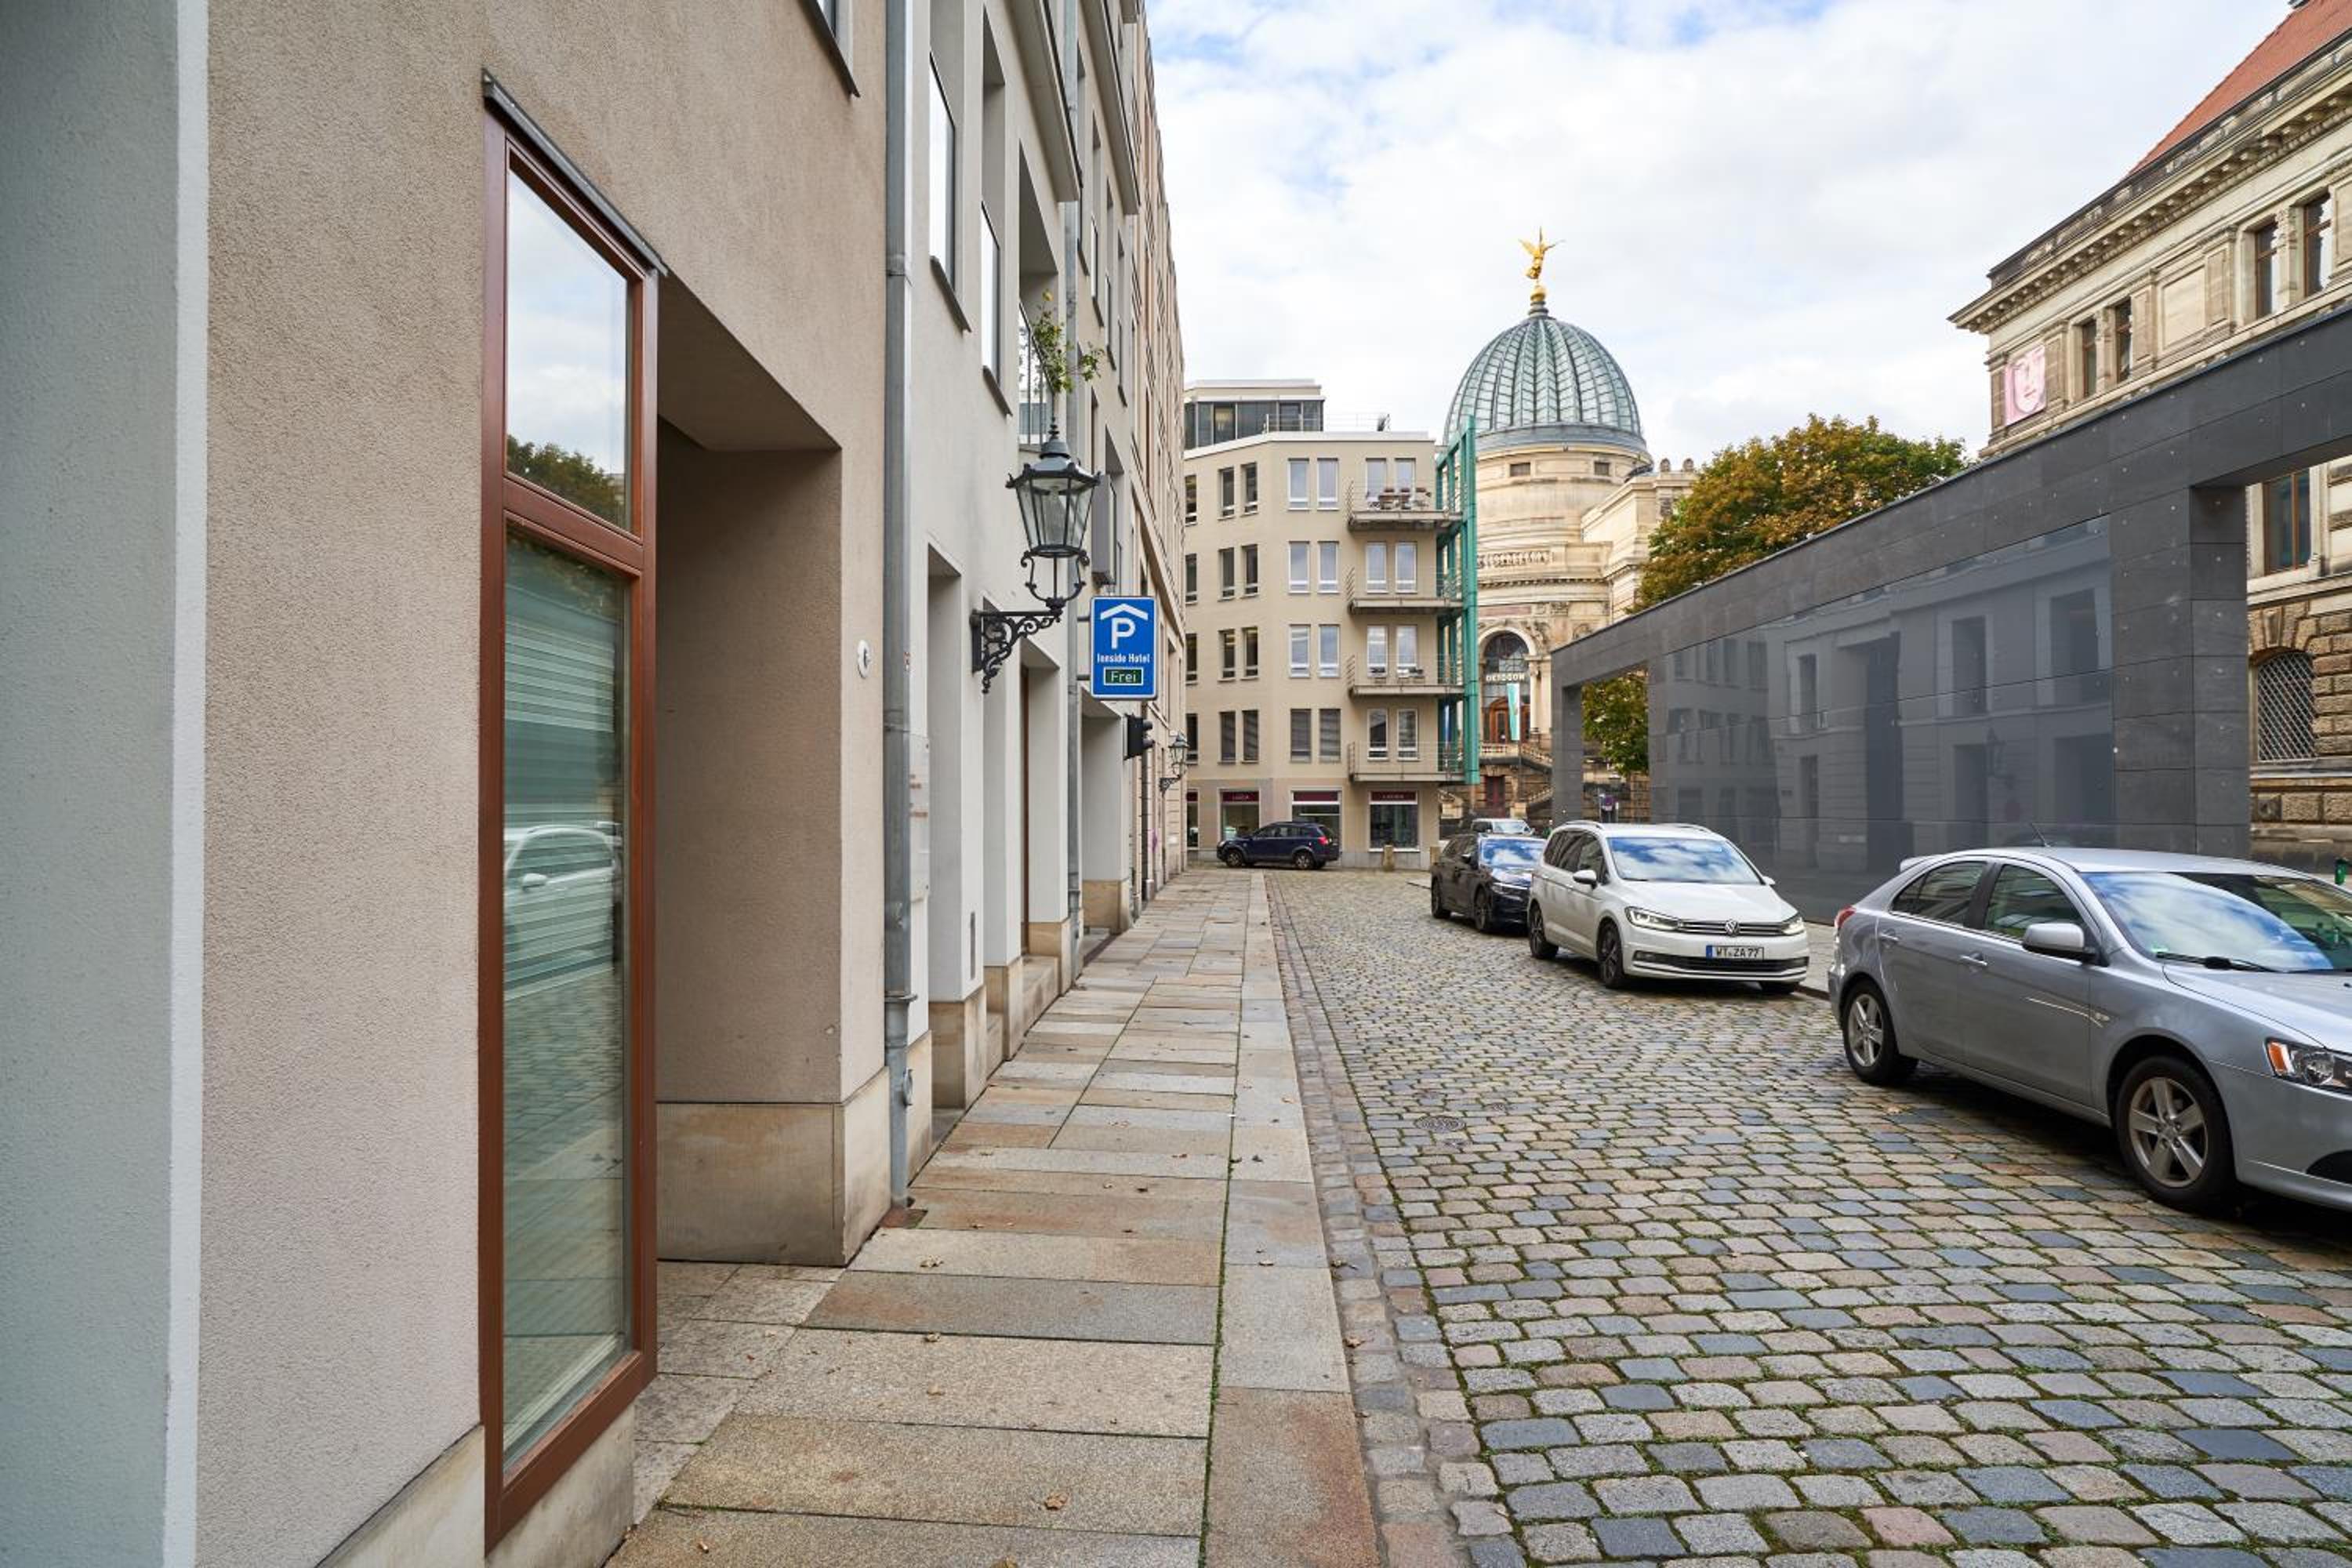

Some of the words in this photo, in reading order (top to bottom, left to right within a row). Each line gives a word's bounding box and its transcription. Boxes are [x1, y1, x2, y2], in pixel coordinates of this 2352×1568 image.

[1111, 617, 1136, 650] P
[1128, 653, 1150, 663] Hotel
[1111, 670, 1137, 682] Frei
